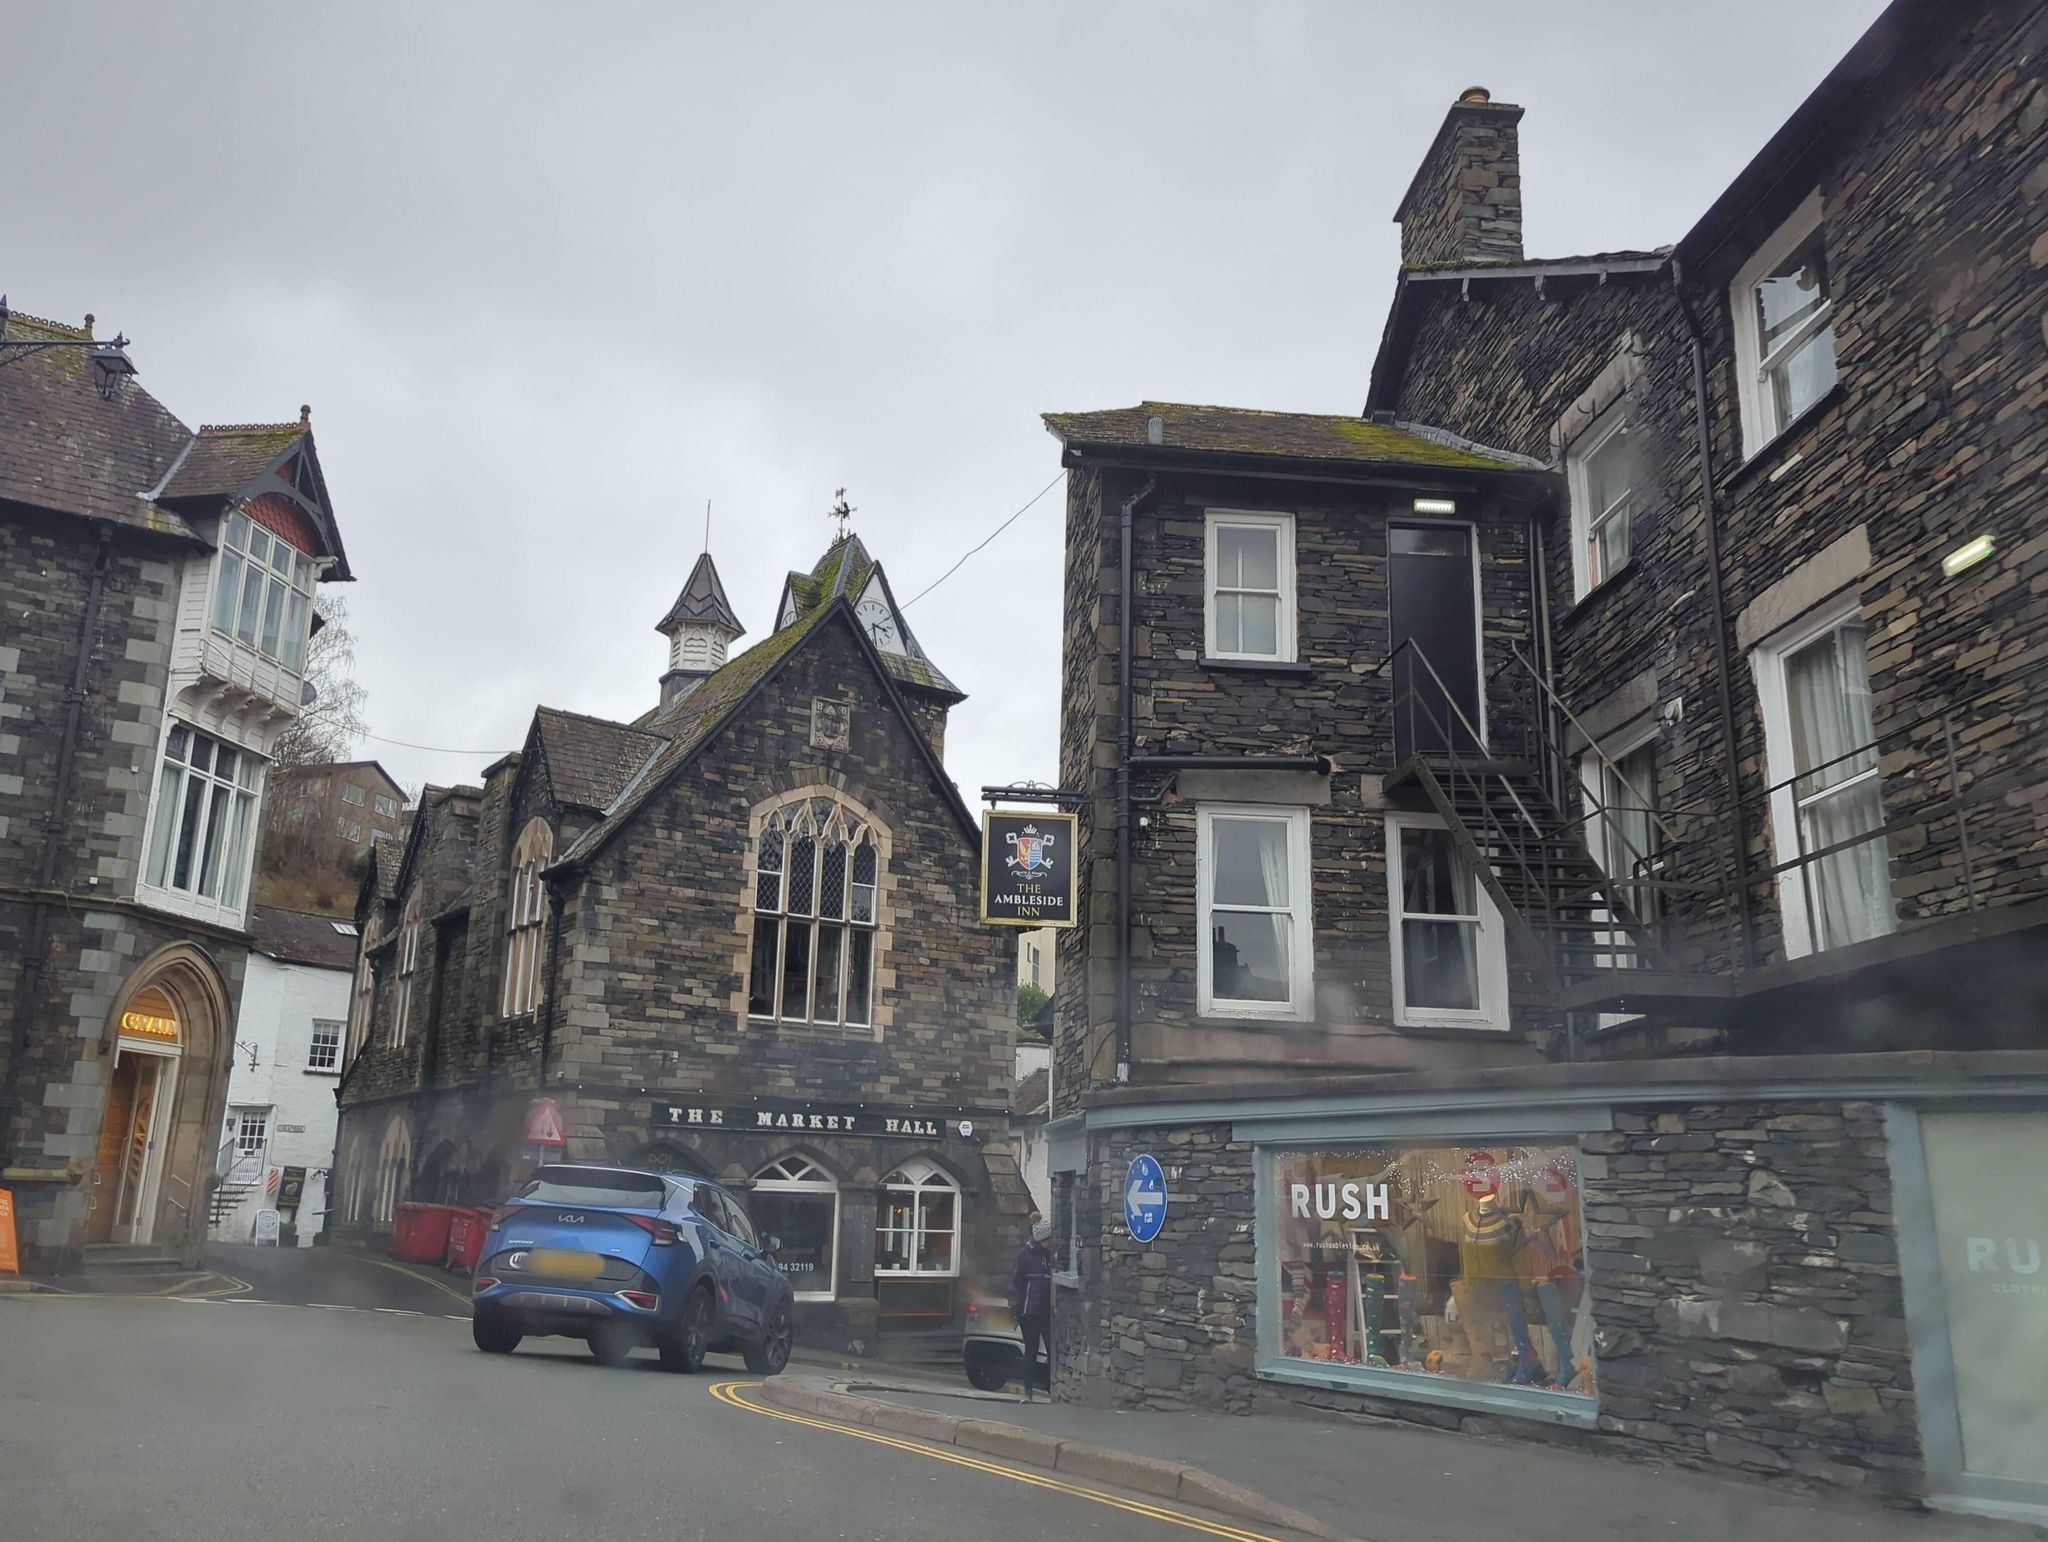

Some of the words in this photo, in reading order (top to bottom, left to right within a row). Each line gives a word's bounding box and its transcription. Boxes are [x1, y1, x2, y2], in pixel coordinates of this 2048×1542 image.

[1016, 883, 1042, 894] THE
[994, 893, 1064, 907] AMBLESIDE
[1017, 906, 1040, 917] INN
[669, 1107, 723, 1124] THE
[757, 1111, 856, 1130] MARKET
[885, 1118, 937, 1135] HALL
[1291, 1183, 1389, 1220] RUSH
[1302, 1240, 1380, 1251] www.rushamblesid.co.uk
[1966, 1237, 2041, 1274] RU
[790, 1262, 814, 1272] 32119
